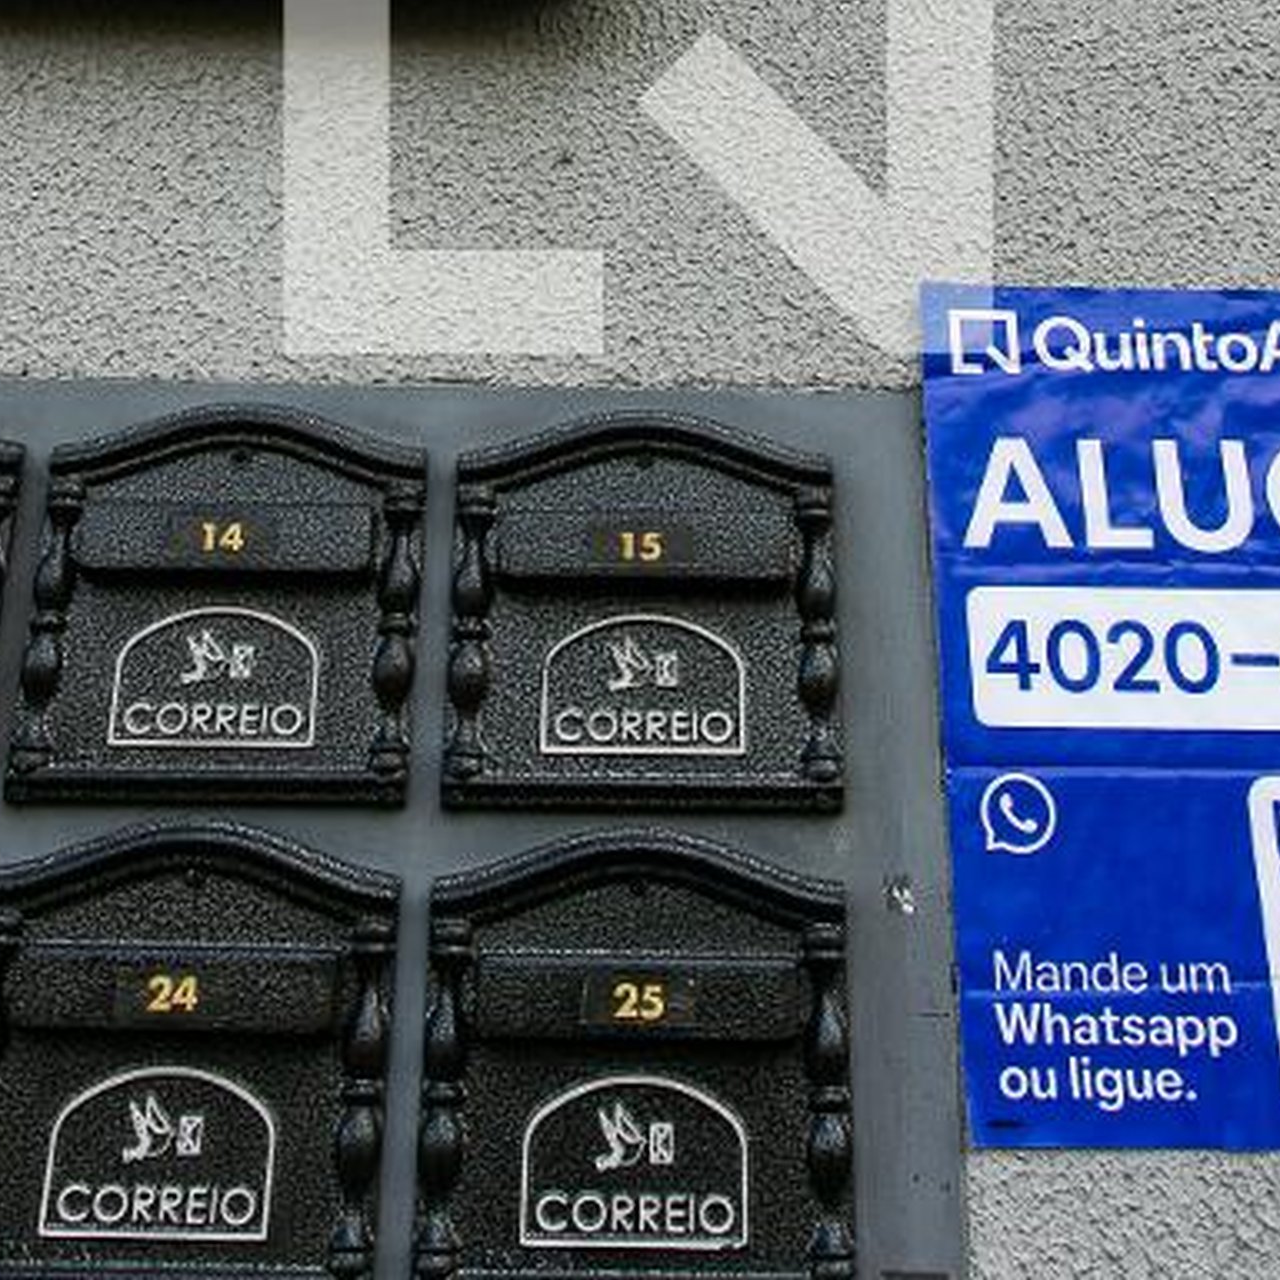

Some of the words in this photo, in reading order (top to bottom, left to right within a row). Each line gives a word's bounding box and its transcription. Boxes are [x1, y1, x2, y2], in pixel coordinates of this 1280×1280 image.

[201, 521, 245, 552] 14
[621, 531, 662, 561] 15
[122, 701, 304, 736] CORREIO
[554, 711, 733, 745] CORREIO
[992, 952, 1150, 993] Mande
[1159, 961, 1232, 994] um
[147, 975, 200, 1013] 24
[613, 982, 666, 1019] 25
[995, 1003, 1239, 1055] Whatsapp
[999, 1065, 1058, 1101] ou
[1069, 1058, 1198, 1112] ligue.
[56, 1184, 256, 1225] CORREIO
[535, 1194, 735, 1235] CORREIO
